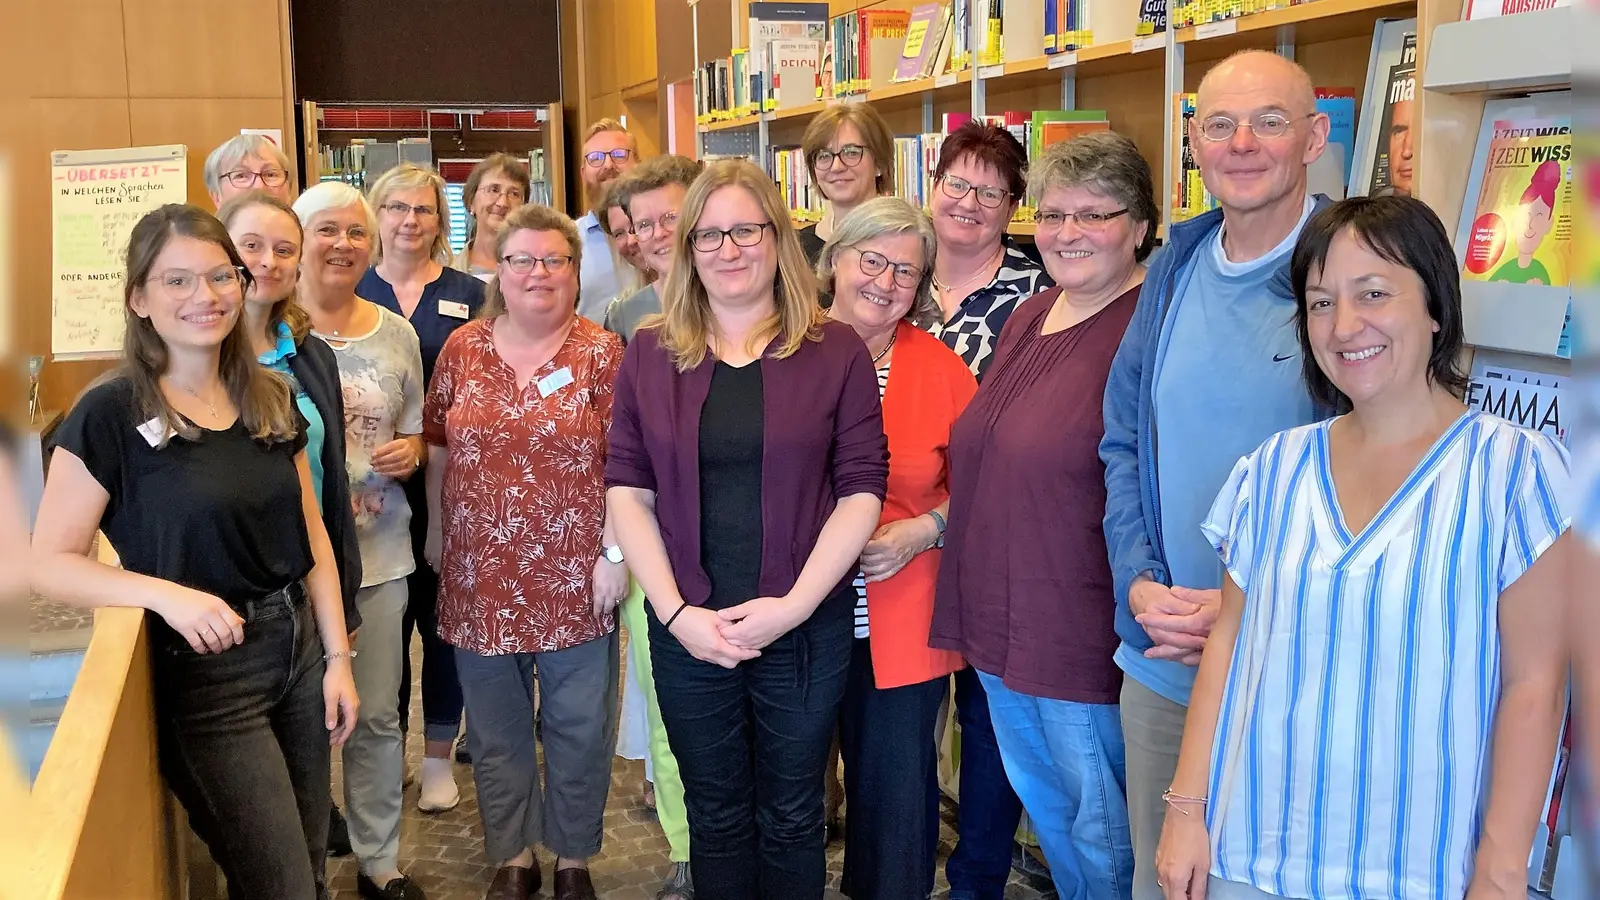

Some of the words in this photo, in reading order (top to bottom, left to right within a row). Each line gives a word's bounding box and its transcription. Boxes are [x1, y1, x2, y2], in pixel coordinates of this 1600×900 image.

[1145, 0, 1166, 12] Gut
[1536, 126, 1571, 137] WIS
[1496, 146, 1530, 165] ZEIT
[1531, 144, 1571, 163] WISS
[74, 187, 116, 195] WELCHEN
[118, 181, 164, 196] Sprachen
[95, 197, 122, 205] LESEN
[60, 273, 82, 281] ODER
[88, 271, 122, 281] ANDERE
[1467, 382, 1559, 436] EMMA
